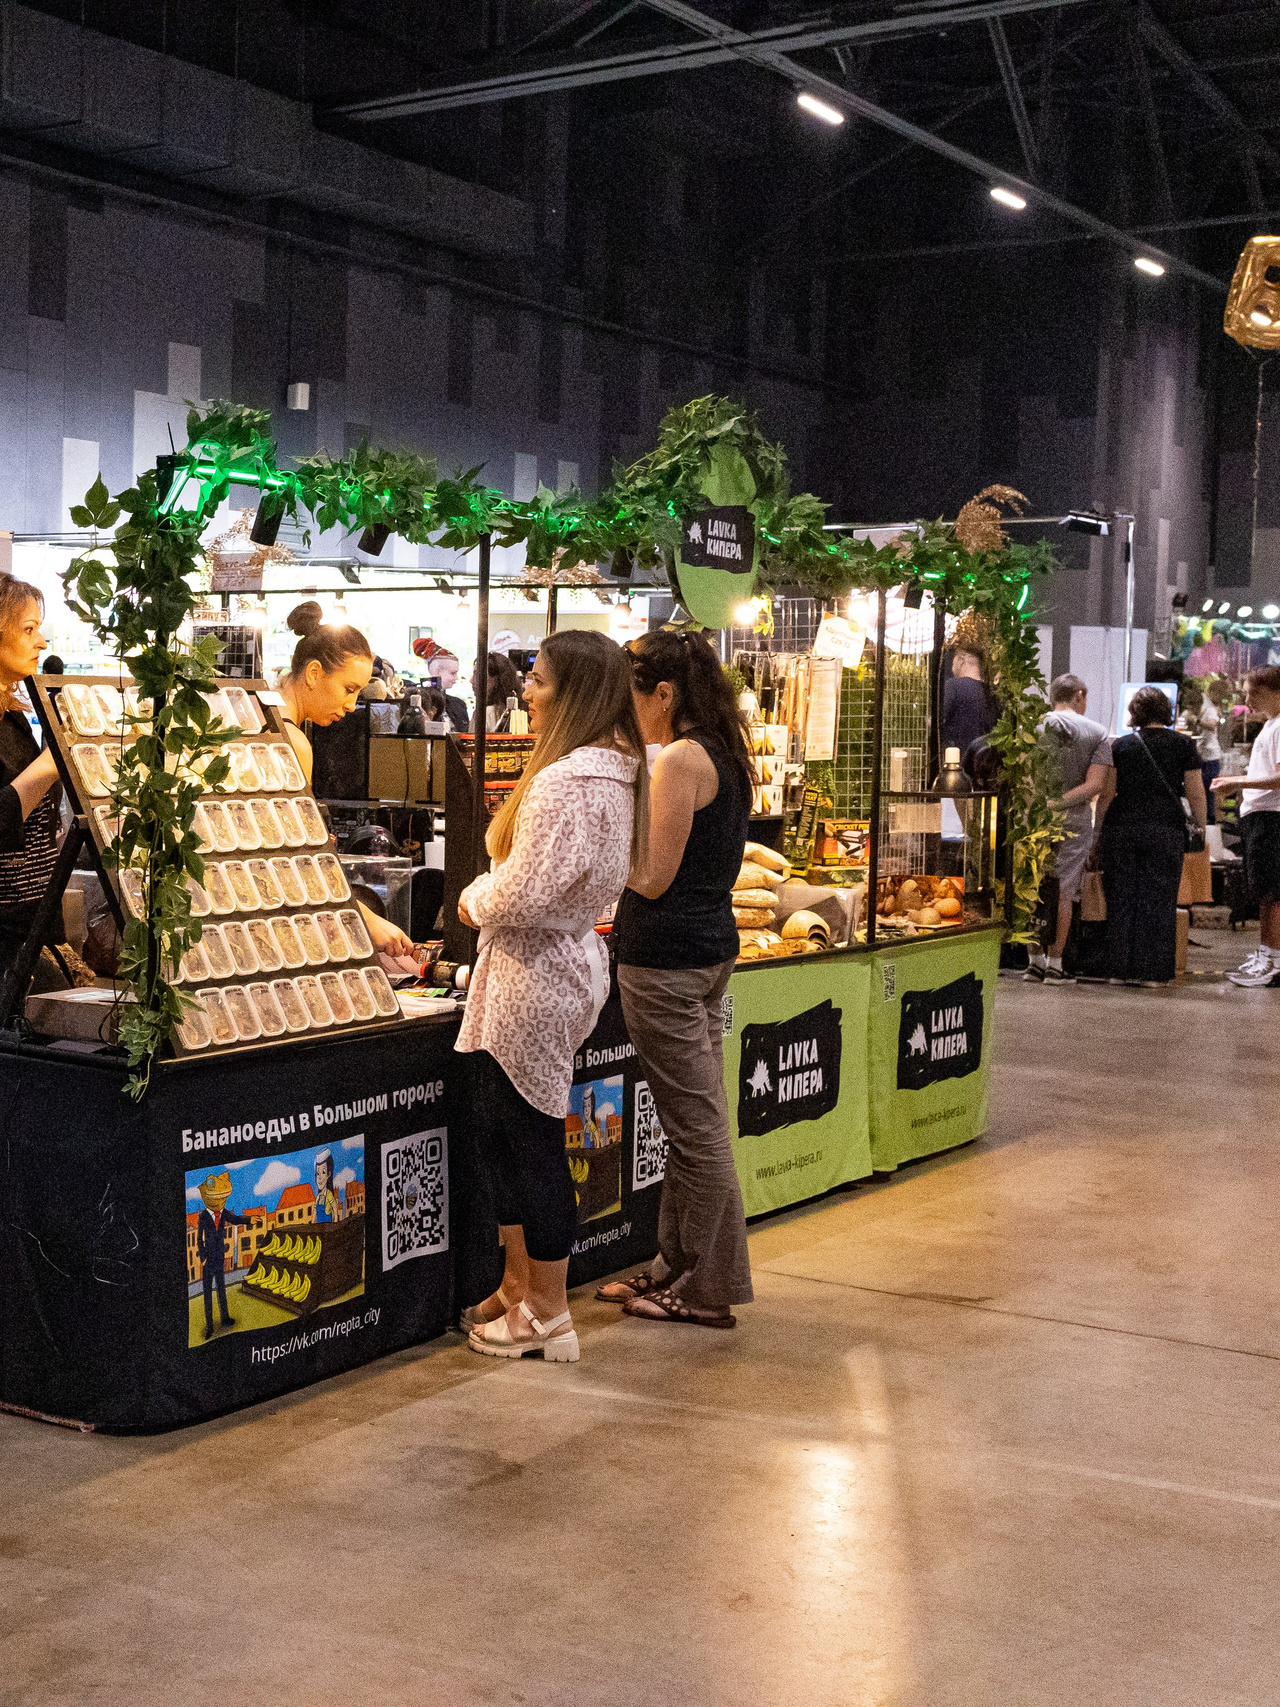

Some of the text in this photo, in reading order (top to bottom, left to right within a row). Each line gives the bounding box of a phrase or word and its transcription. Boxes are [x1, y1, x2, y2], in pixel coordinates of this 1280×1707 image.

[707, 519, 737, 540] LAVKA
[706, 538, 741, 561] КИПЕРА
[931, 1005, 963, 1033] LAVKA
[779, 1038, 819, 1072] LAVKA
[931, 1031, 967, 1061] КИПЕРА
[575, 1054, 583, 1070] в
[778, 1067, 823, 1103] КИПЕРА
[181, 1079, 444, 1153] Бананоеды в Большом городе
[251, 1307, 381, 1364] https://vk.com/repta_city
